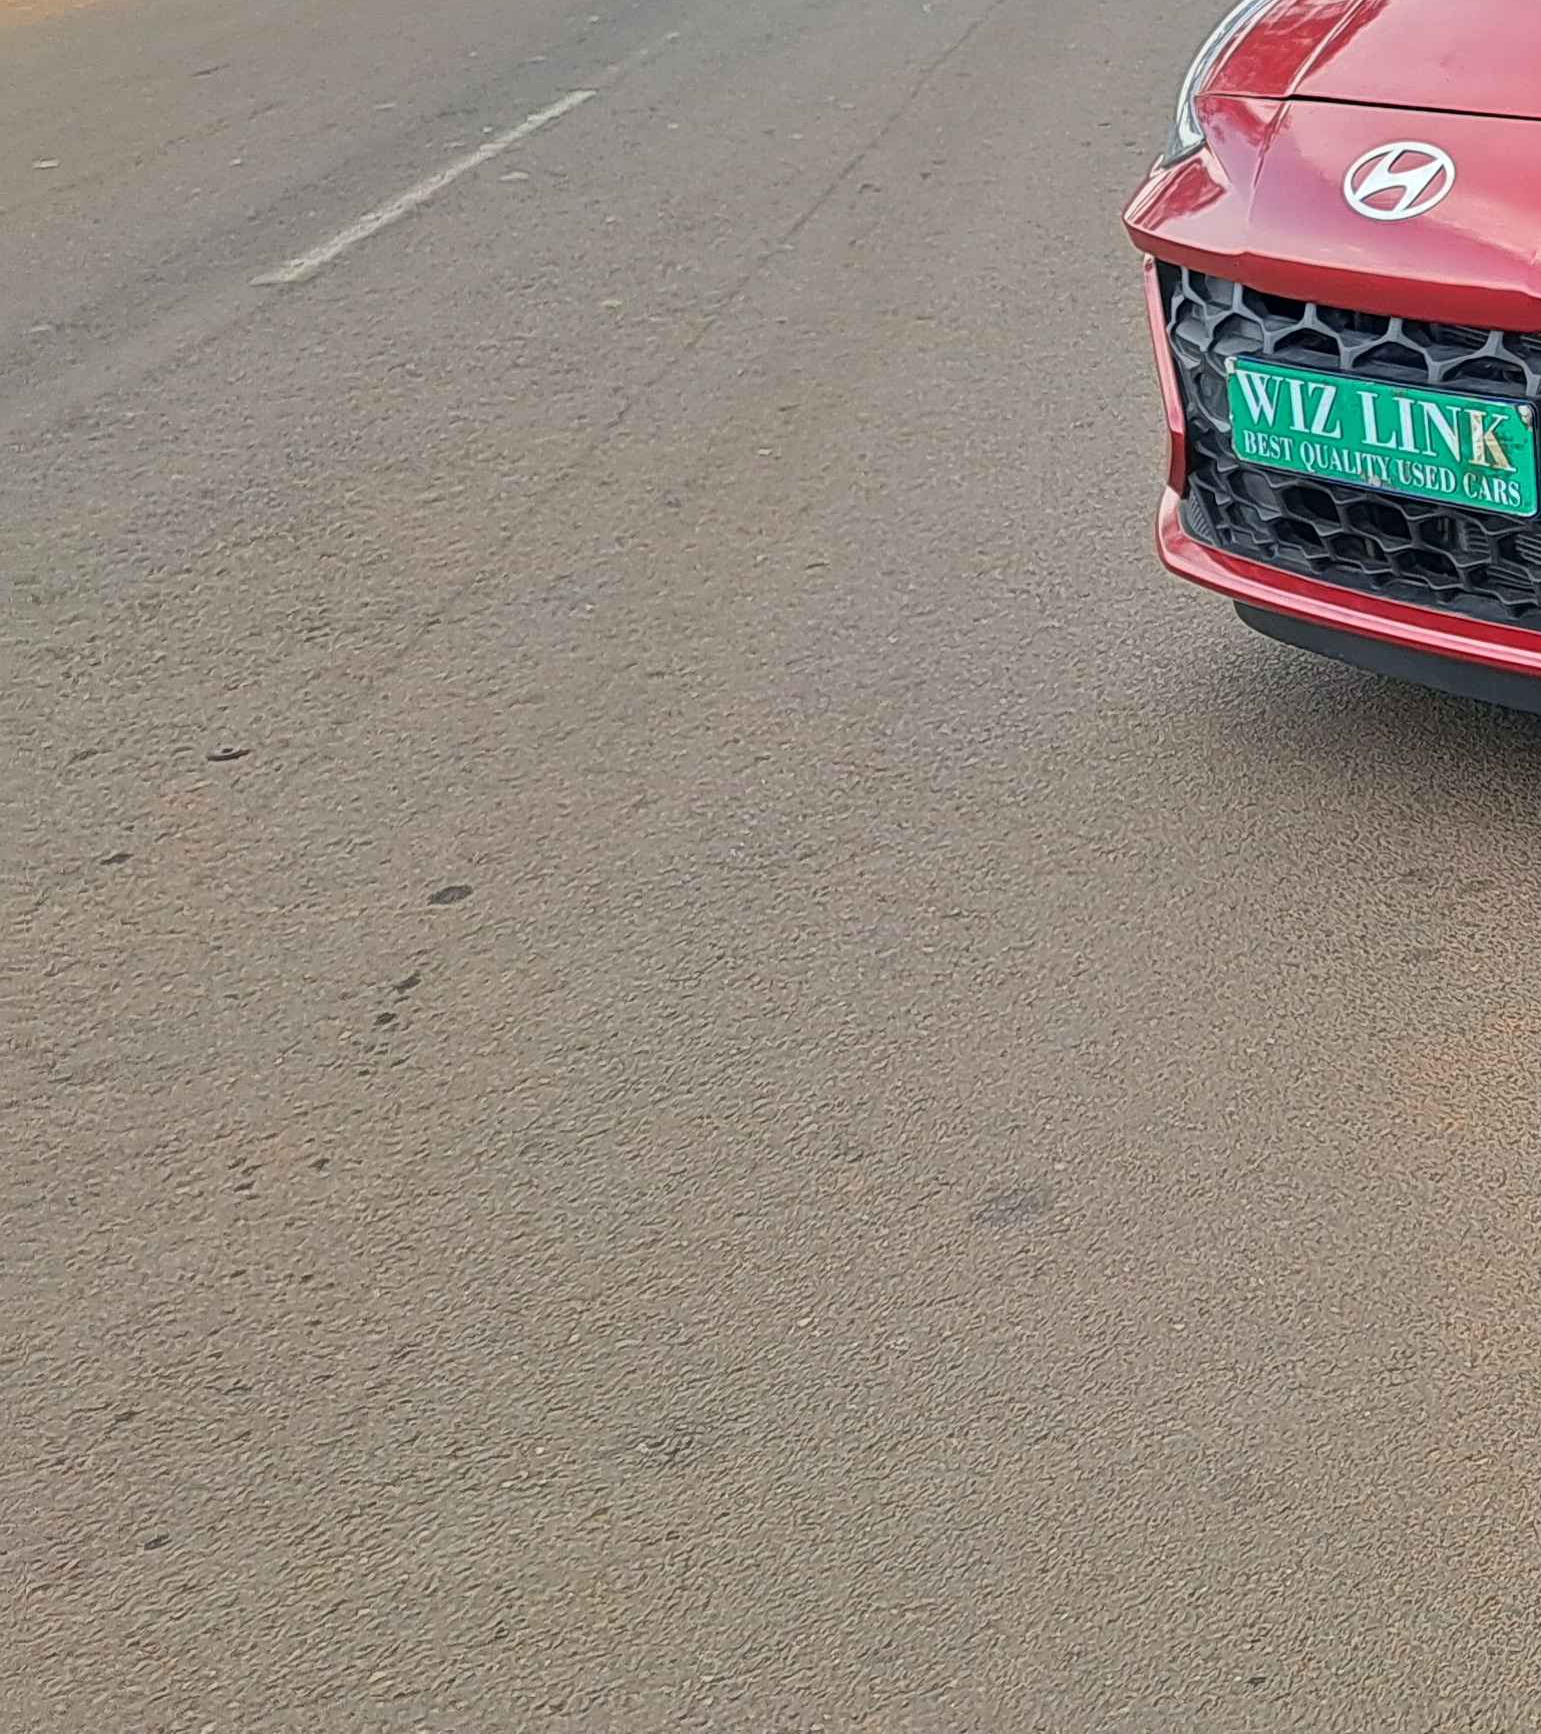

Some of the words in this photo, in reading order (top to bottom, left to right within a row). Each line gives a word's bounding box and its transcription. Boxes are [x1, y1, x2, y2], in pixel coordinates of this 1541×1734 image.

[1234, 369, 1342, 439] WIZ
[1357, 390, 1517, 473] LINK
[1243, 430, 1293, 462] BEST
[1300, 441, 1391, 482] QUALITY
[1395, 458, 1456, 495] USED
[1463, 472, 1521, 508] CARS
